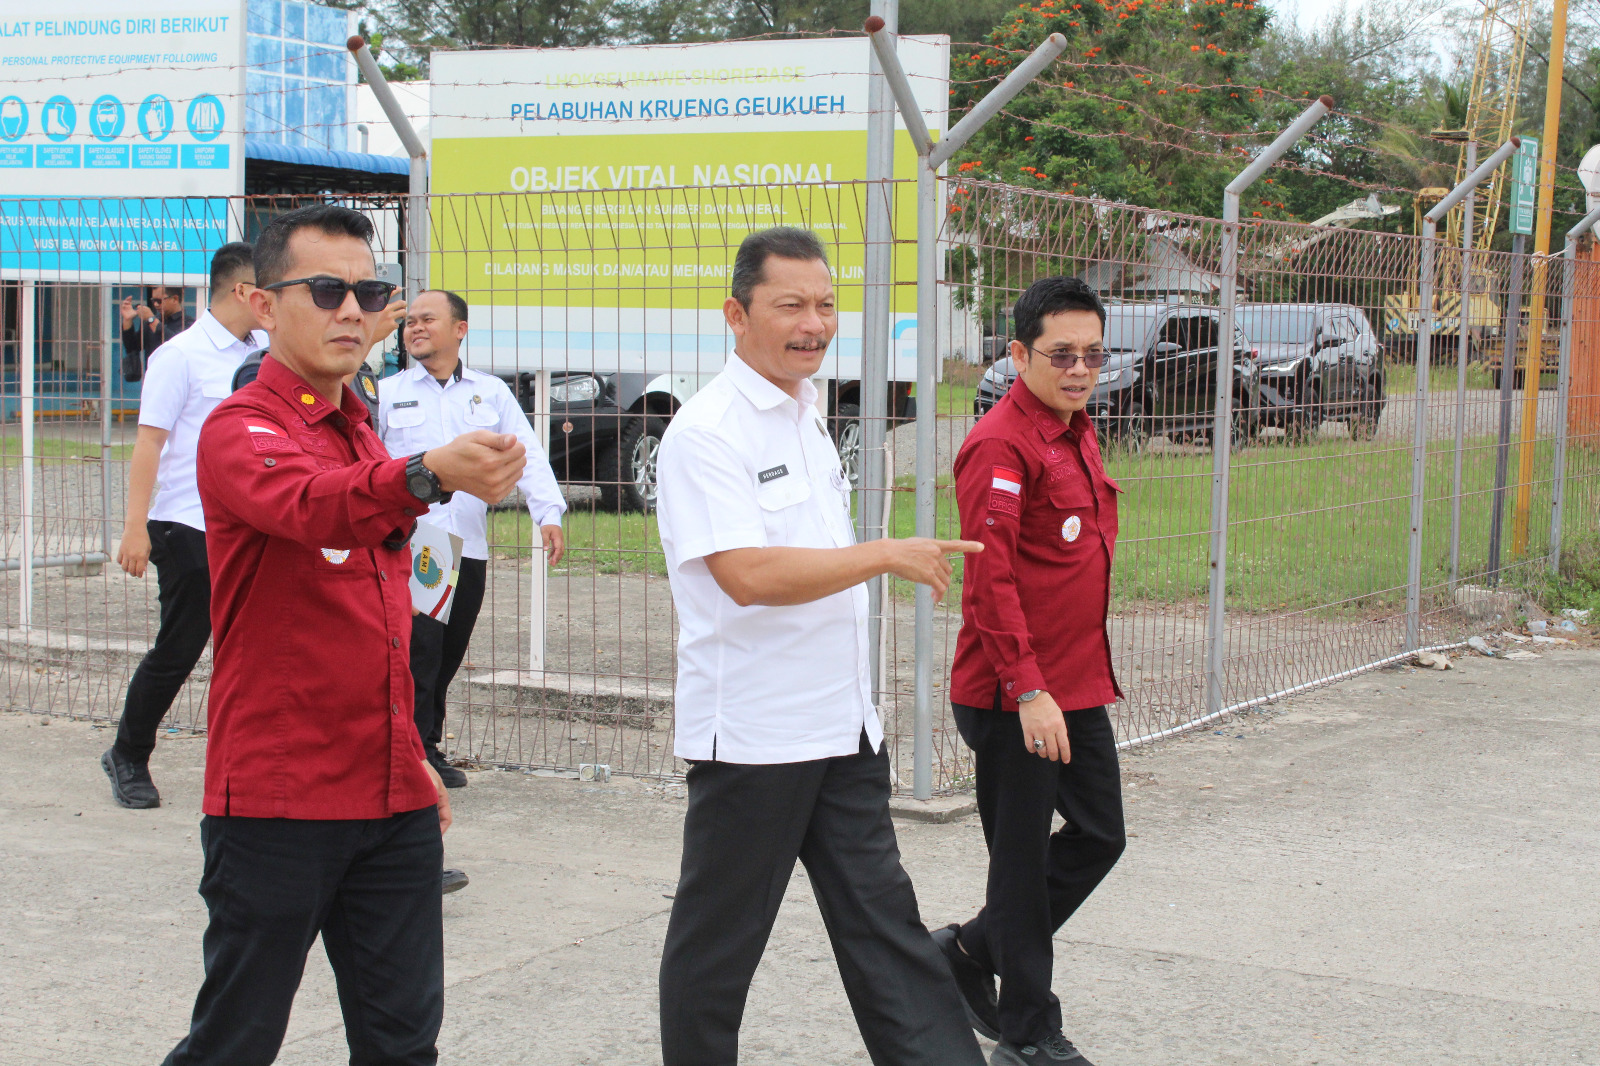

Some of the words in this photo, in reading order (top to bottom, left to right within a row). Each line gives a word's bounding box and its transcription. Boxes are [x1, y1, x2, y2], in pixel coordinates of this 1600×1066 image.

[34, 19, 121, 37] PELINDUNG
[126, 18, 156, 35] DIRI
[161, 16, 229, 34] BERIKUT
[2, 56, 49, 66] PERSONAL
[51, 55, 106, 65] PROTECTIVE
[108, 54, 161, 65] EQUIPMENT
[162, 52, 218, 64] FOLLOWING
[691, 66, 807, 86] SHOREBASE
[511, 100, 633, 121] PELABUHAN
[640, 98, 729, 118] KRUENG
[735, 95, 845, 116] GEUKUEH
[510, 165, 600, 192] OBJEK
[608, 164, 679, 191] VITAL
[692, 163, 841, 189] NASIONAL
[541, 204, 581, 216] BIDANG
[584, 204, 626, 216] ENERGI
[628, 204, 651, 215] DAN
[654, 204, 702, 215] SUMBER
[704, 204, 734, 215] DAYA
[736, 203, 788, 215] MINERAL
[26, 217, 83, 228] DIGUNAKAN
[84, 217, 125, 228] SELAMA
[126, 218, 168, 229] BERADA
[169, 218, 180, 229] DI
[181, 219, 210, 230] AREA
[212, 219, 225, 230] INI
[33, 238, 59, 249] MUST
[62, 239, 76, 250] BE
[78, 239, 107, 250] WORN
[150, 241, 178, 251] AREA
[484, 263, 550, 276] DILARANG
[553, 264, 599, 276] MASUK
[602, 264, 669, 277] DAN/ATAU
[420, 546, 430, 574] KAMI
